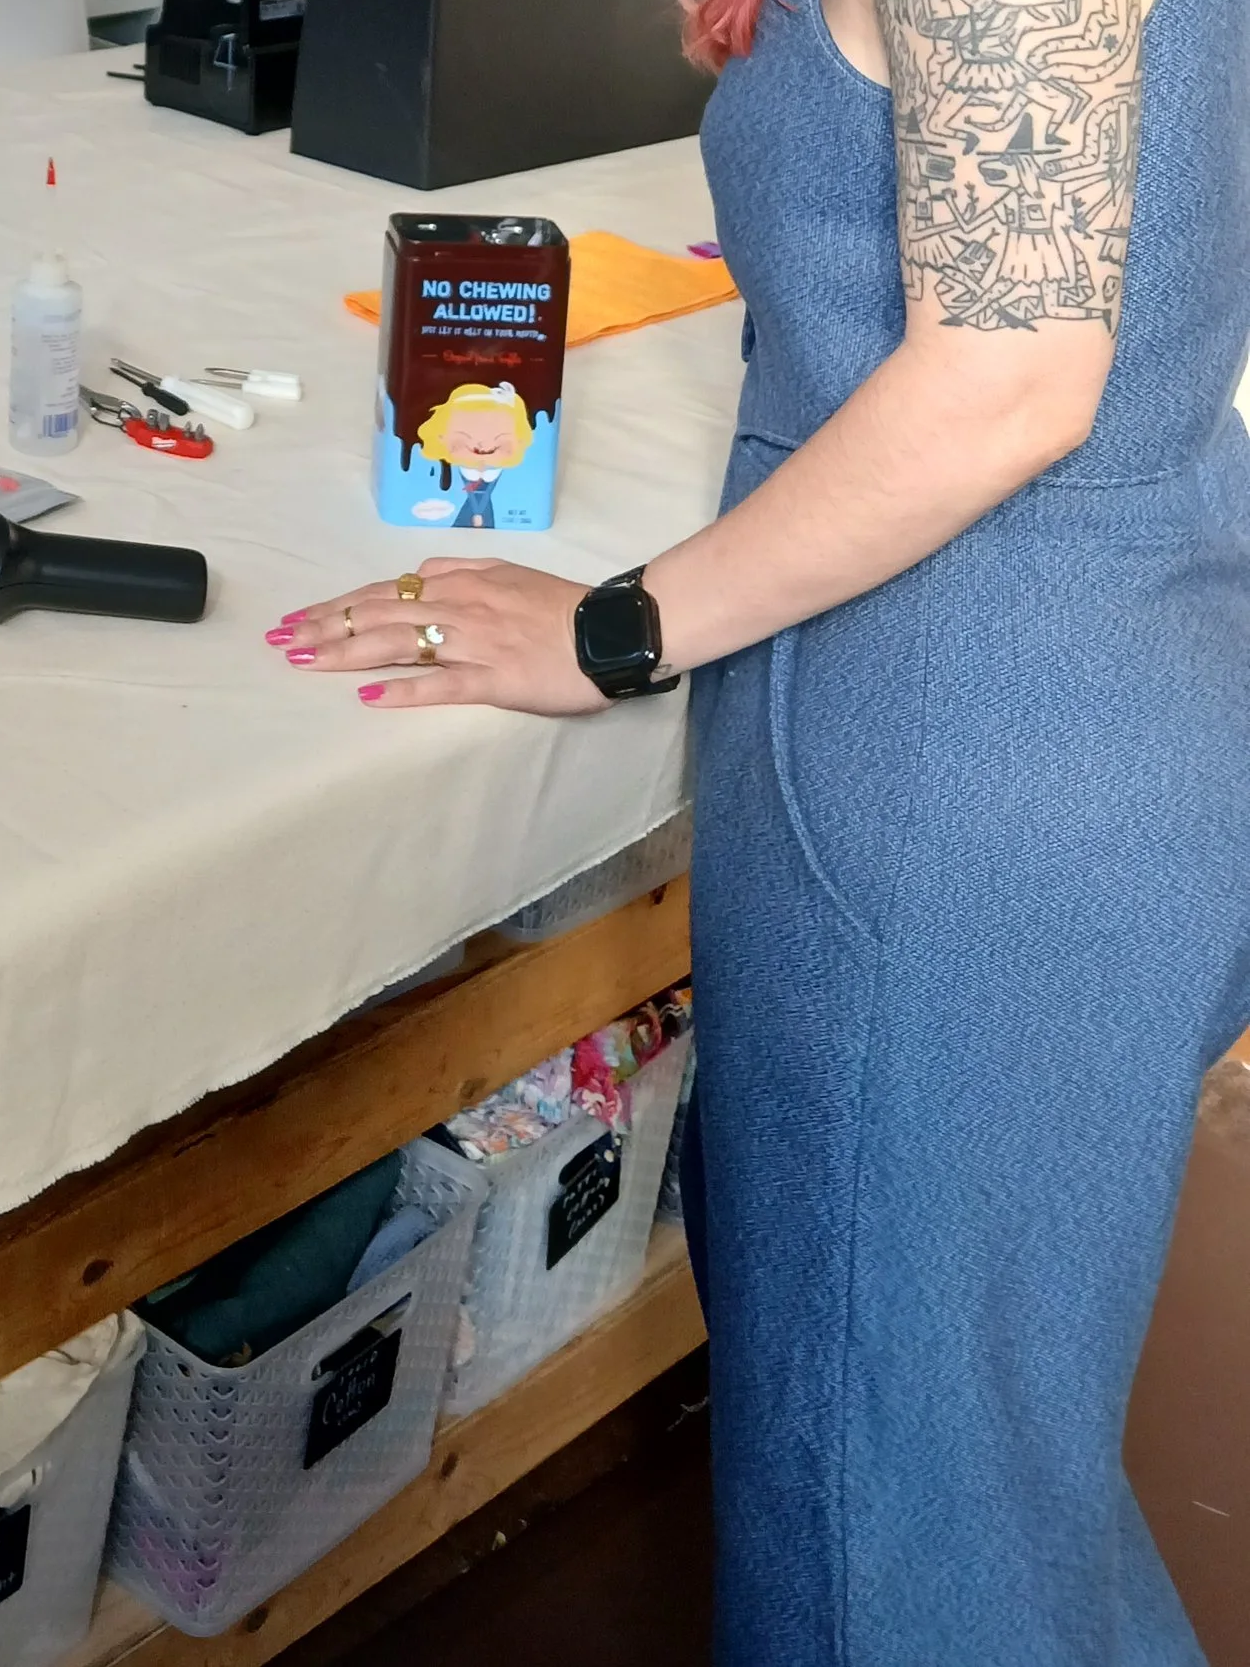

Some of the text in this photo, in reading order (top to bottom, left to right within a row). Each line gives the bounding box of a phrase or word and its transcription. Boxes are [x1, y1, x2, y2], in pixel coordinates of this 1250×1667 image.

[421, 279, 551, 301] NO CHEWING
[433, 303, 537, 324] ALLOWED!
